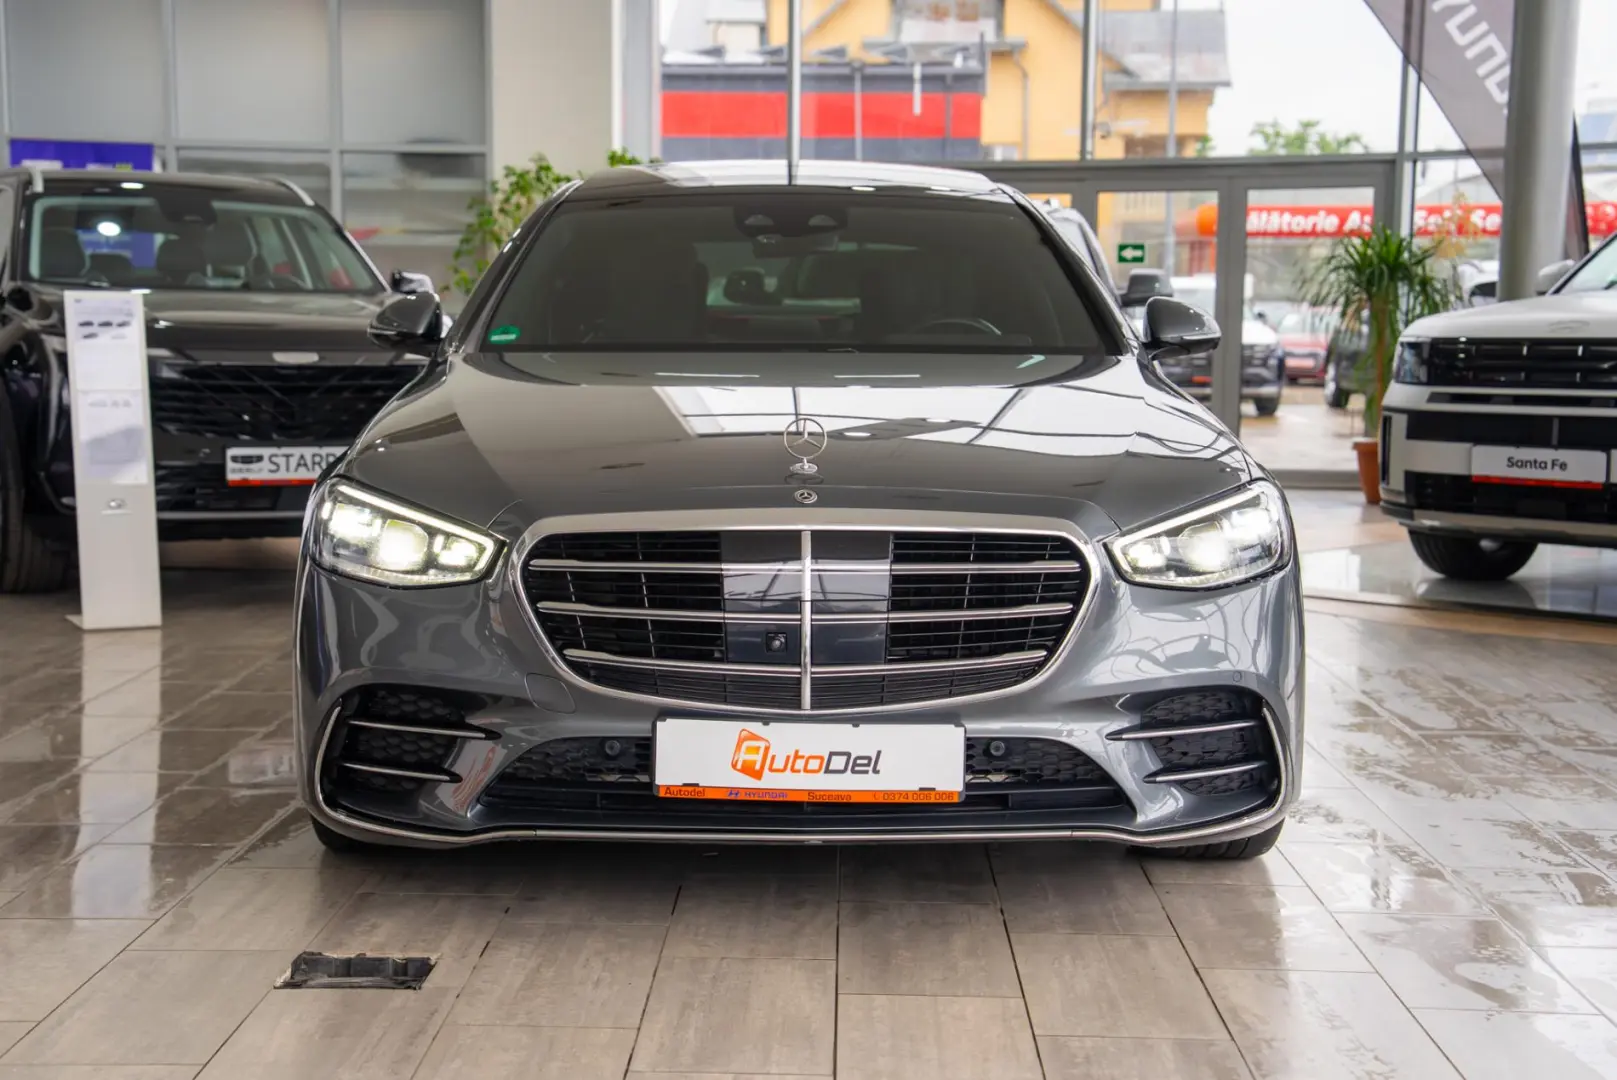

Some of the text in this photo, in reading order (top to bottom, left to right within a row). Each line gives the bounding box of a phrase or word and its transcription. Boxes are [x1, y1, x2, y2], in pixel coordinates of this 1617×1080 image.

[1432, 0, 1510, 116] YUND
[1506, 456, 1568, 471] Santa Fe
[735, 734, 882, 778] AutoDel
[664, 786, 954, 801] Autodel HYUNDAI Suceava 0374 006 006
